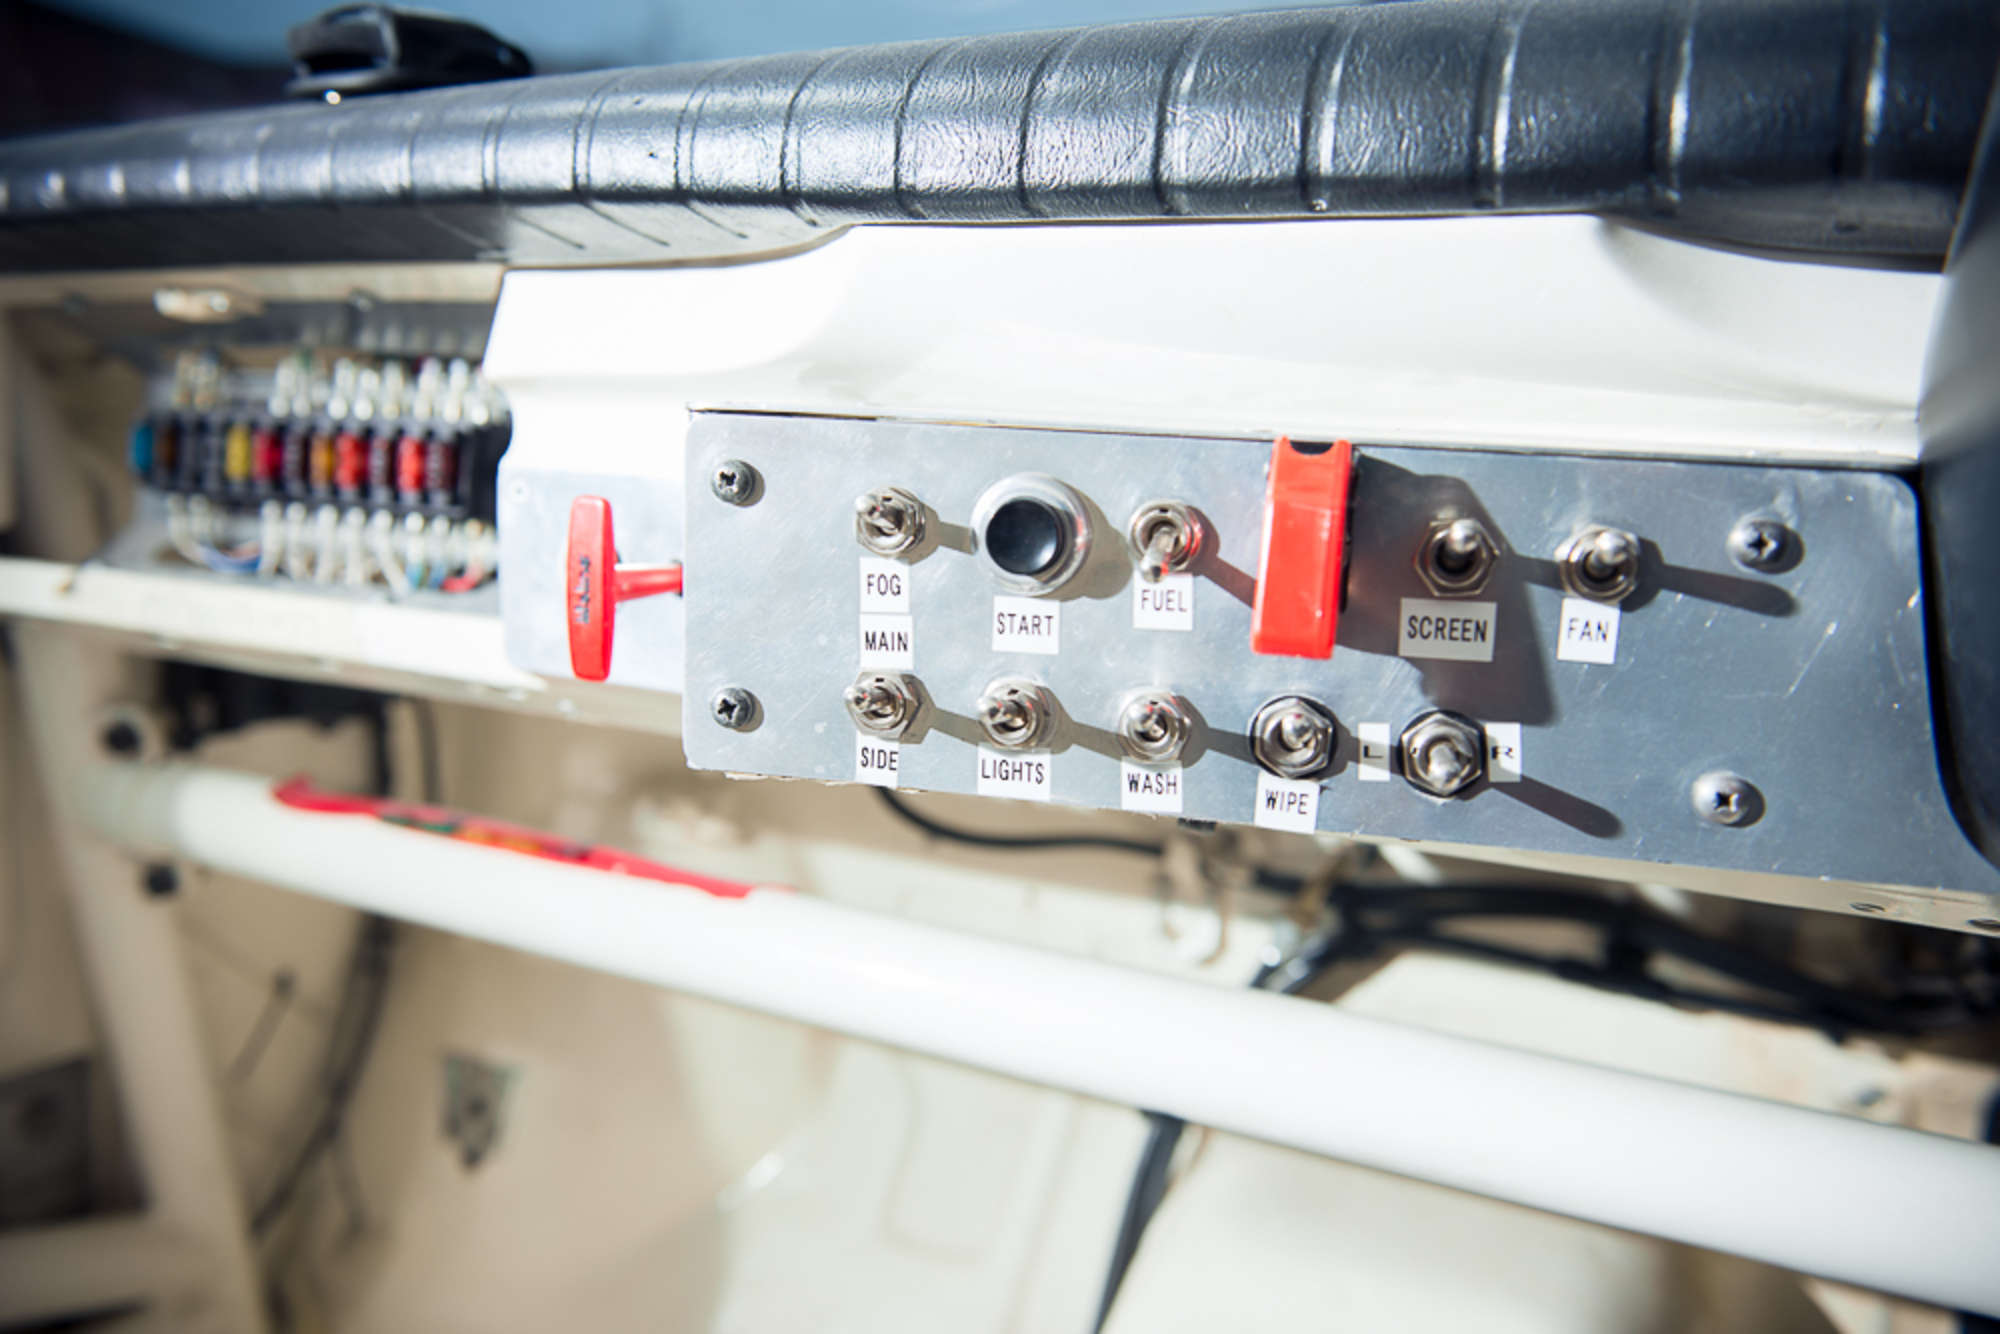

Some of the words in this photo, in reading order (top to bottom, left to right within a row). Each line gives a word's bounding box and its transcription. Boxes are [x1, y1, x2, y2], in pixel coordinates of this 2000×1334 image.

[867, 574, 901, 596] FOG
[1142, 590, 1188, 612] FUEL
[997, 613, 1054, 637] START
[1407, 615, 1487, 642] SCREEN
[1567, 617, 1609, 643] FAN
[865, 632, 908, 652] MAIN
[861, 748, 899, 771] SIDE
[1363, 744, 1385, 759] L
[1491, 746, 1514, 760] R
[981, 760, 1045, 785] LIGHTS
[1127, 773, 1178, 795] WASH
[1265, 790, 1309, 815] WIPE
